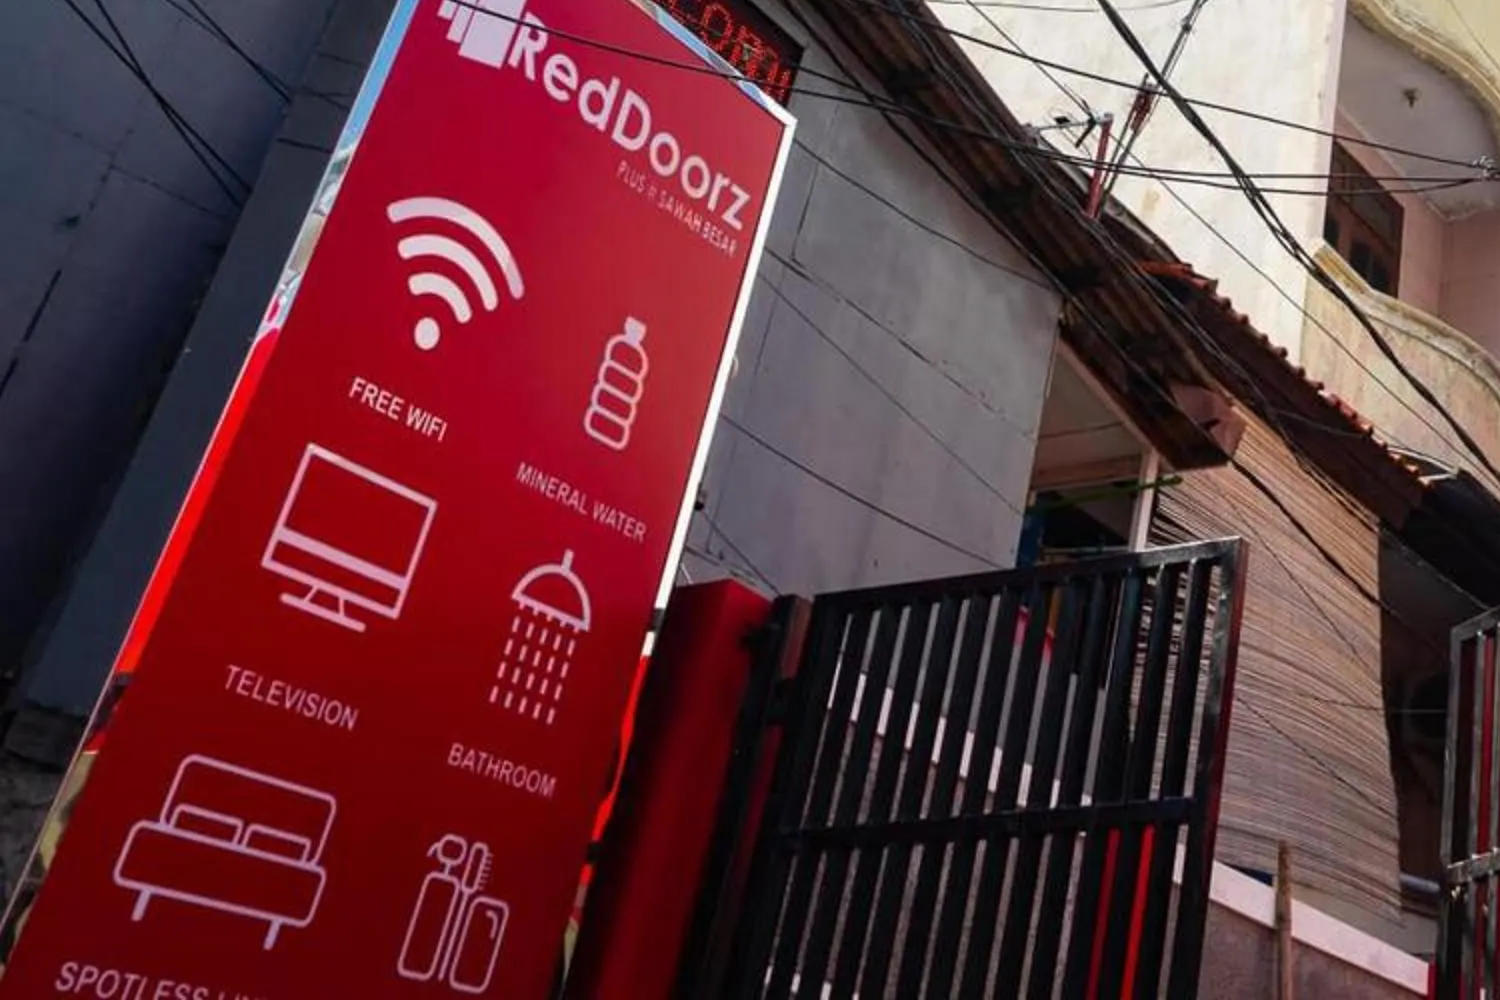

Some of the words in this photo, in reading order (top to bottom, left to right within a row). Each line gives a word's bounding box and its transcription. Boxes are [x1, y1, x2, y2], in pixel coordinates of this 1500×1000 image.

[507, 11, 750, 231] RedDoorz
[617, 160, 646, 193] PLUS
[658, 190, 702, 233] SAWAH
[702, 221, 738, 258] BESAR
[348, 376, 405, 420] FREE
[406, 404, 448, 442] WIFI
[516, 461, 588, 515] MINERAL
[592, 500, 647, 543] WATER
[225, 664, 359, 731] TELEVISION
[448, 743, 557, 797] BATHROOM
